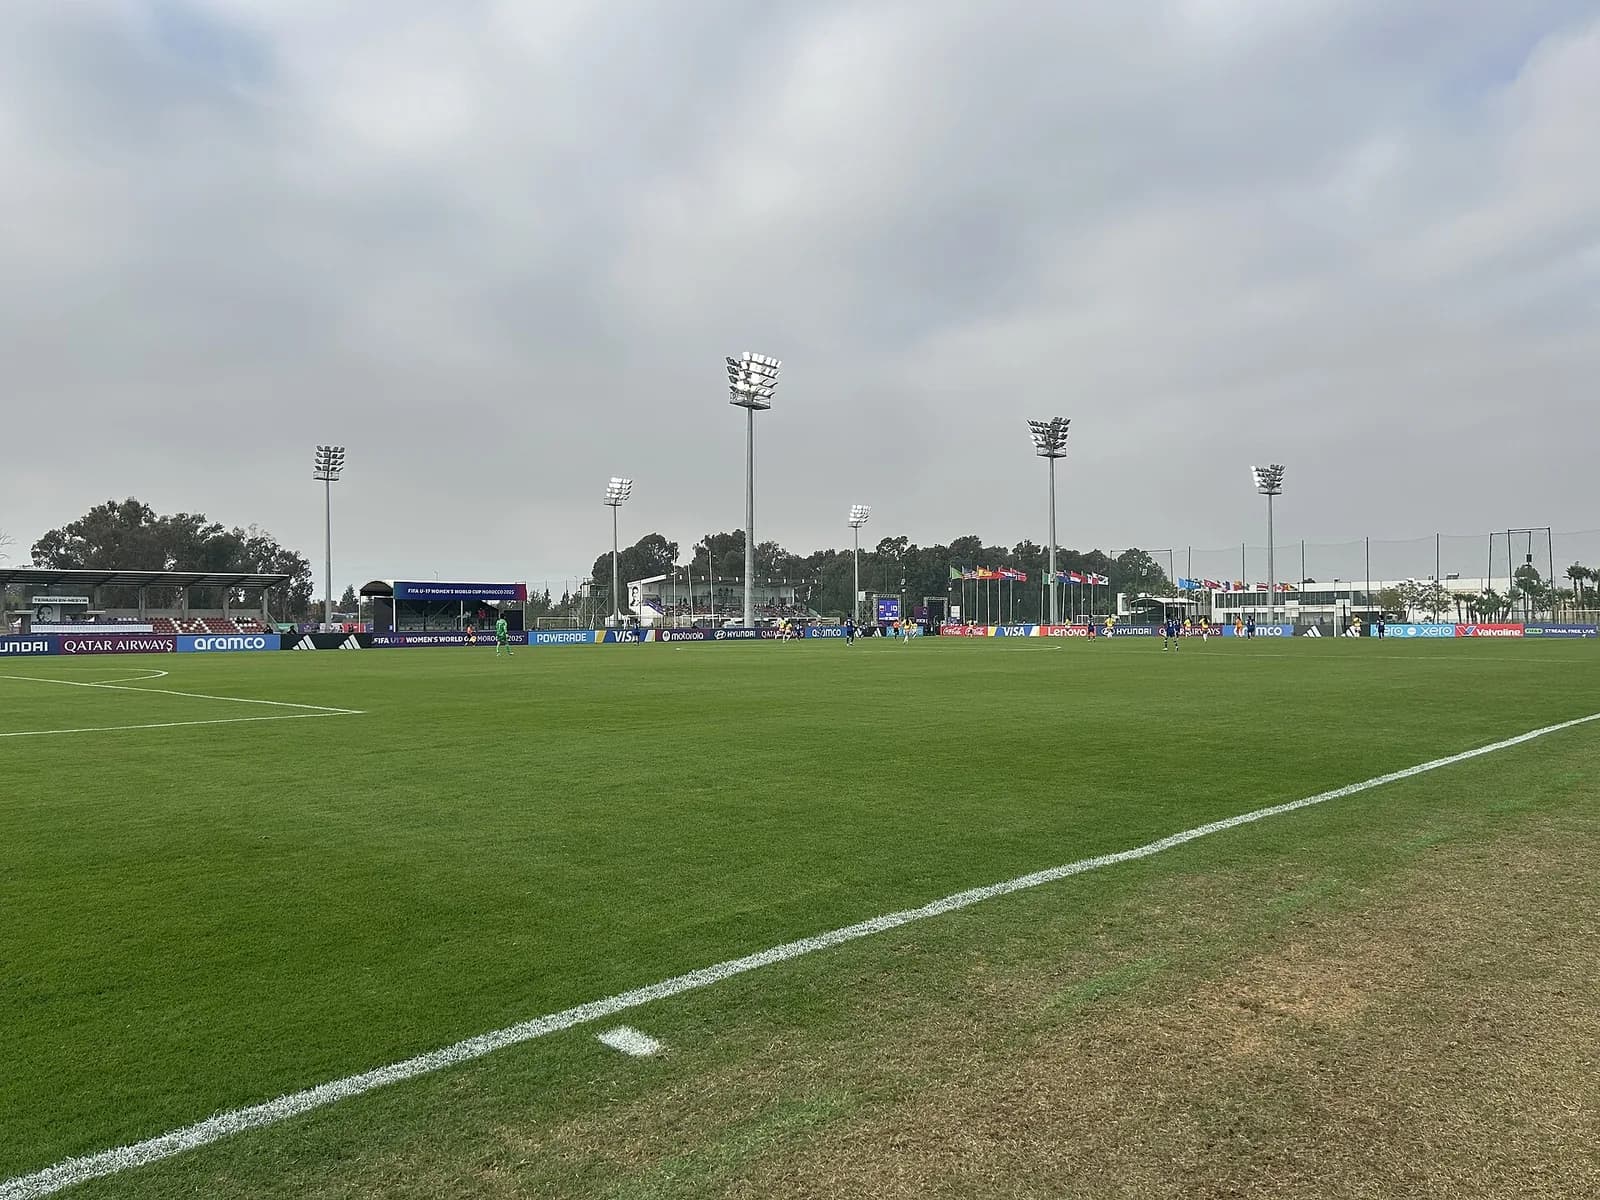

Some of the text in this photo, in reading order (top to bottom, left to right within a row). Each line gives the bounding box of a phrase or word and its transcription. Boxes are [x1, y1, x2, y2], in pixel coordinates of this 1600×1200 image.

[1003, 627, 1025, 636] VISA
[1048, 627, 1086, 636] Lenovo
[1421, 627, 1452, 635] xero
[537, 633, 587, 643] POWERADE
[64, 640, 173, 652] QATAR AIRWAYS
[194, 637, 265, 650] aramco
